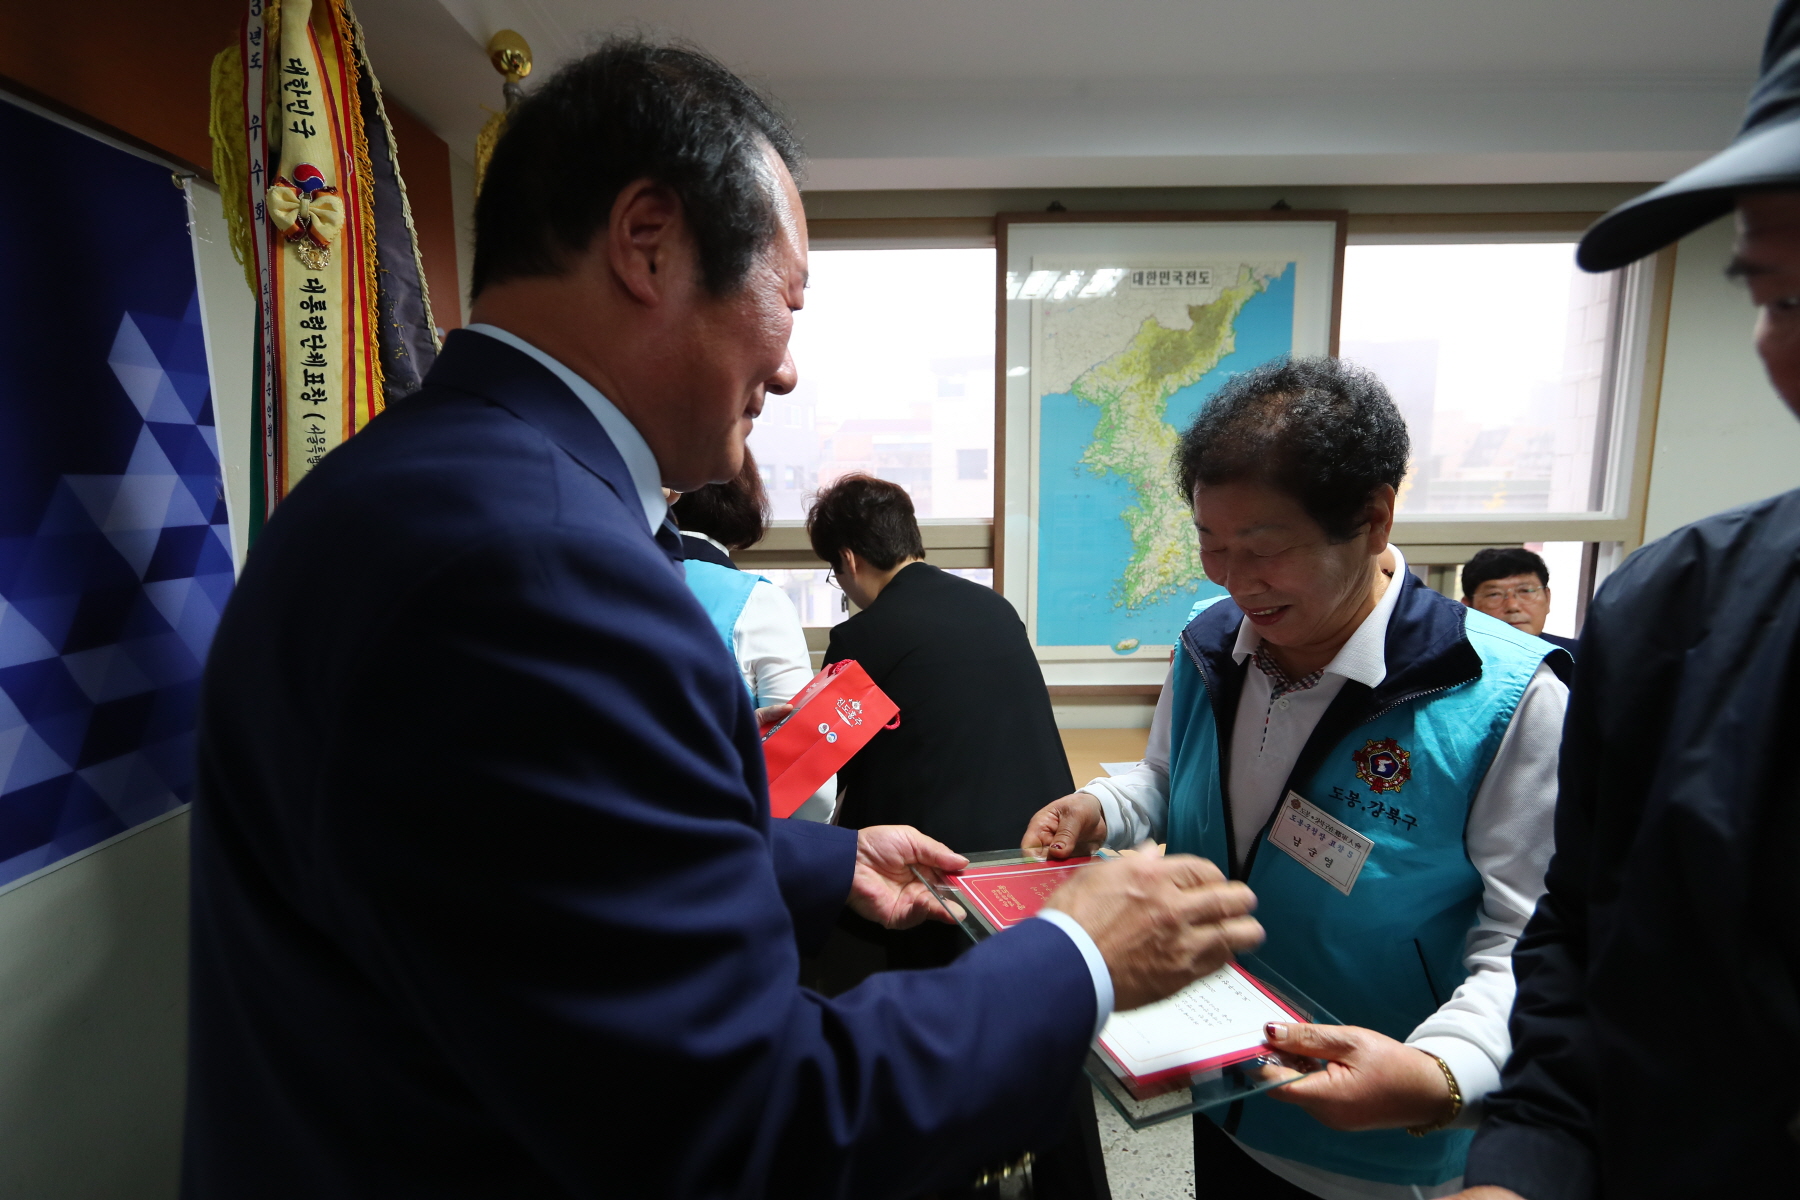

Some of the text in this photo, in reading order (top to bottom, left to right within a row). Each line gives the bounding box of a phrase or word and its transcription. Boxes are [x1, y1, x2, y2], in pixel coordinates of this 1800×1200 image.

[283, 57, 317, 139] 대한민국
[1132, 270, 1210, 285] 대한민국전도
[299, 277, 328, 408] 대통령단체표창
[837, 697, 863, 726] 진도홍주
[1289, 814, 1326, 841] 도봉구청장
[1329, 840, 1345, 854] 표창
